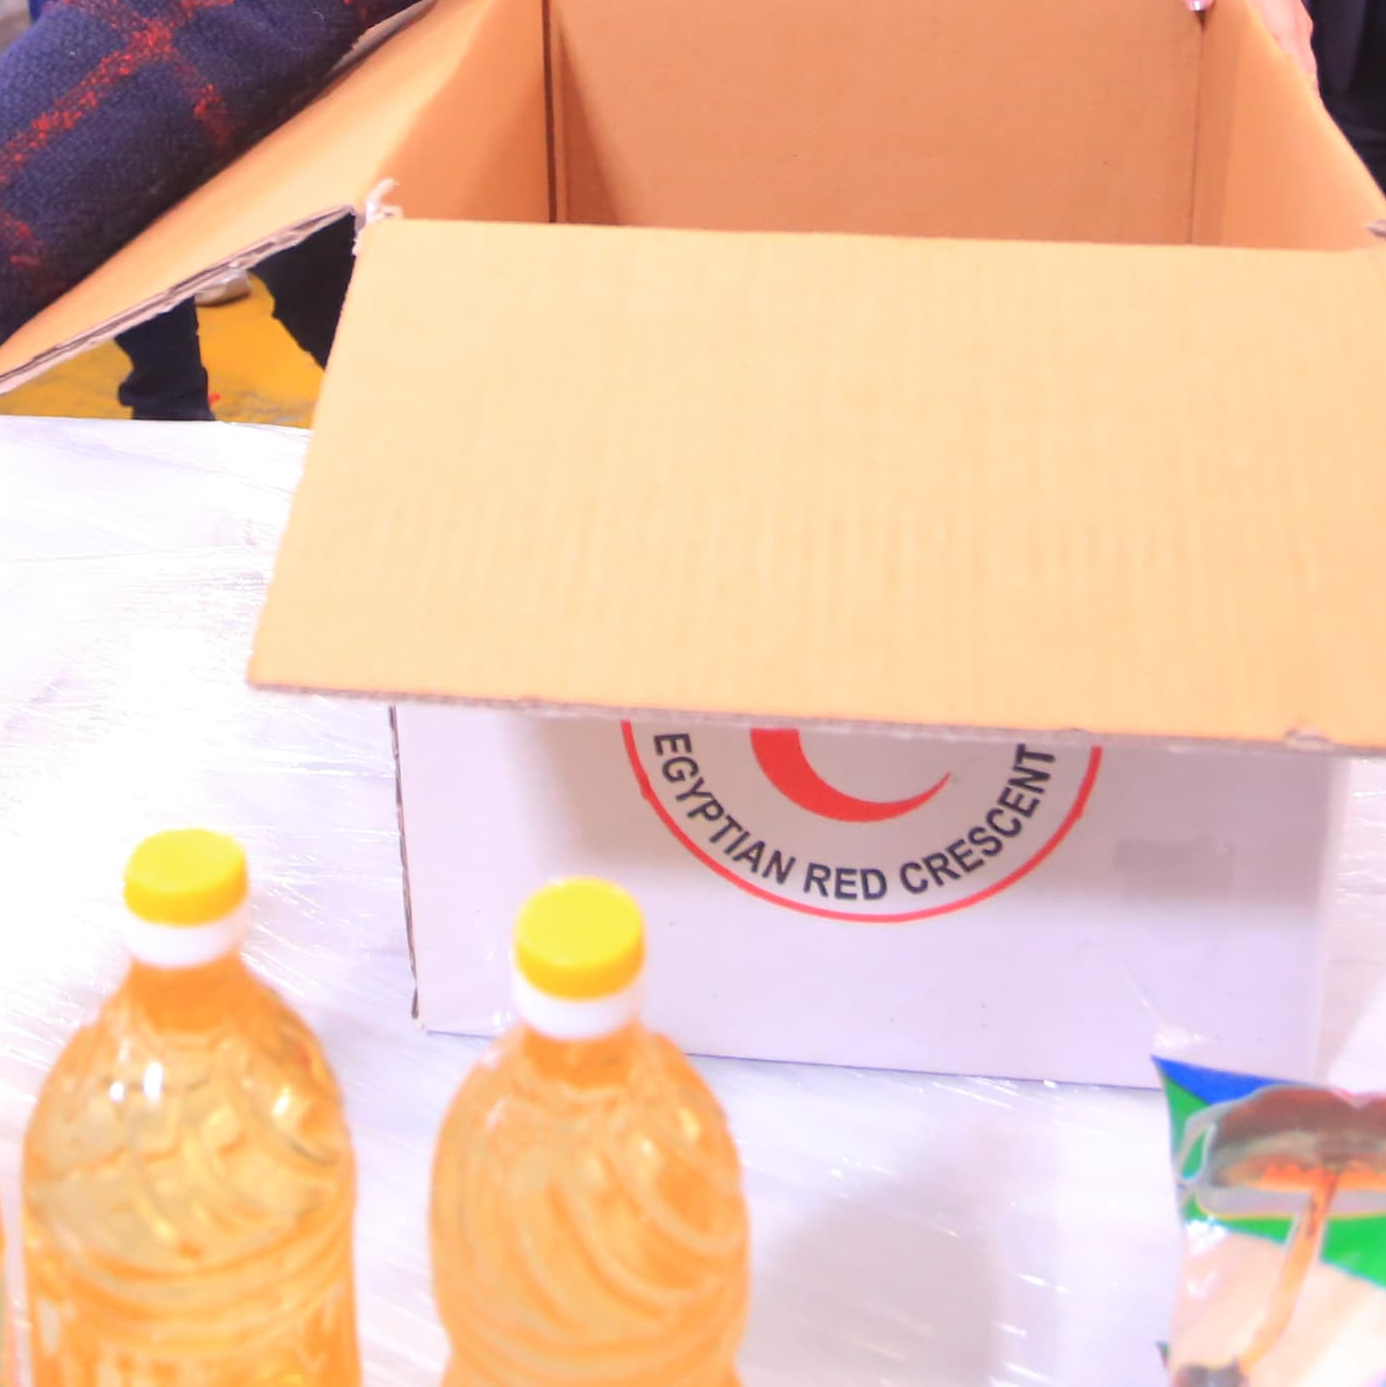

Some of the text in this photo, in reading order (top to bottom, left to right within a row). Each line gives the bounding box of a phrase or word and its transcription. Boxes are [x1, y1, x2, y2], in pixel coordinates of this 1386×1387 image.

[653, 732, 1057, 901] EGYPTIAN RED CRESCENT
